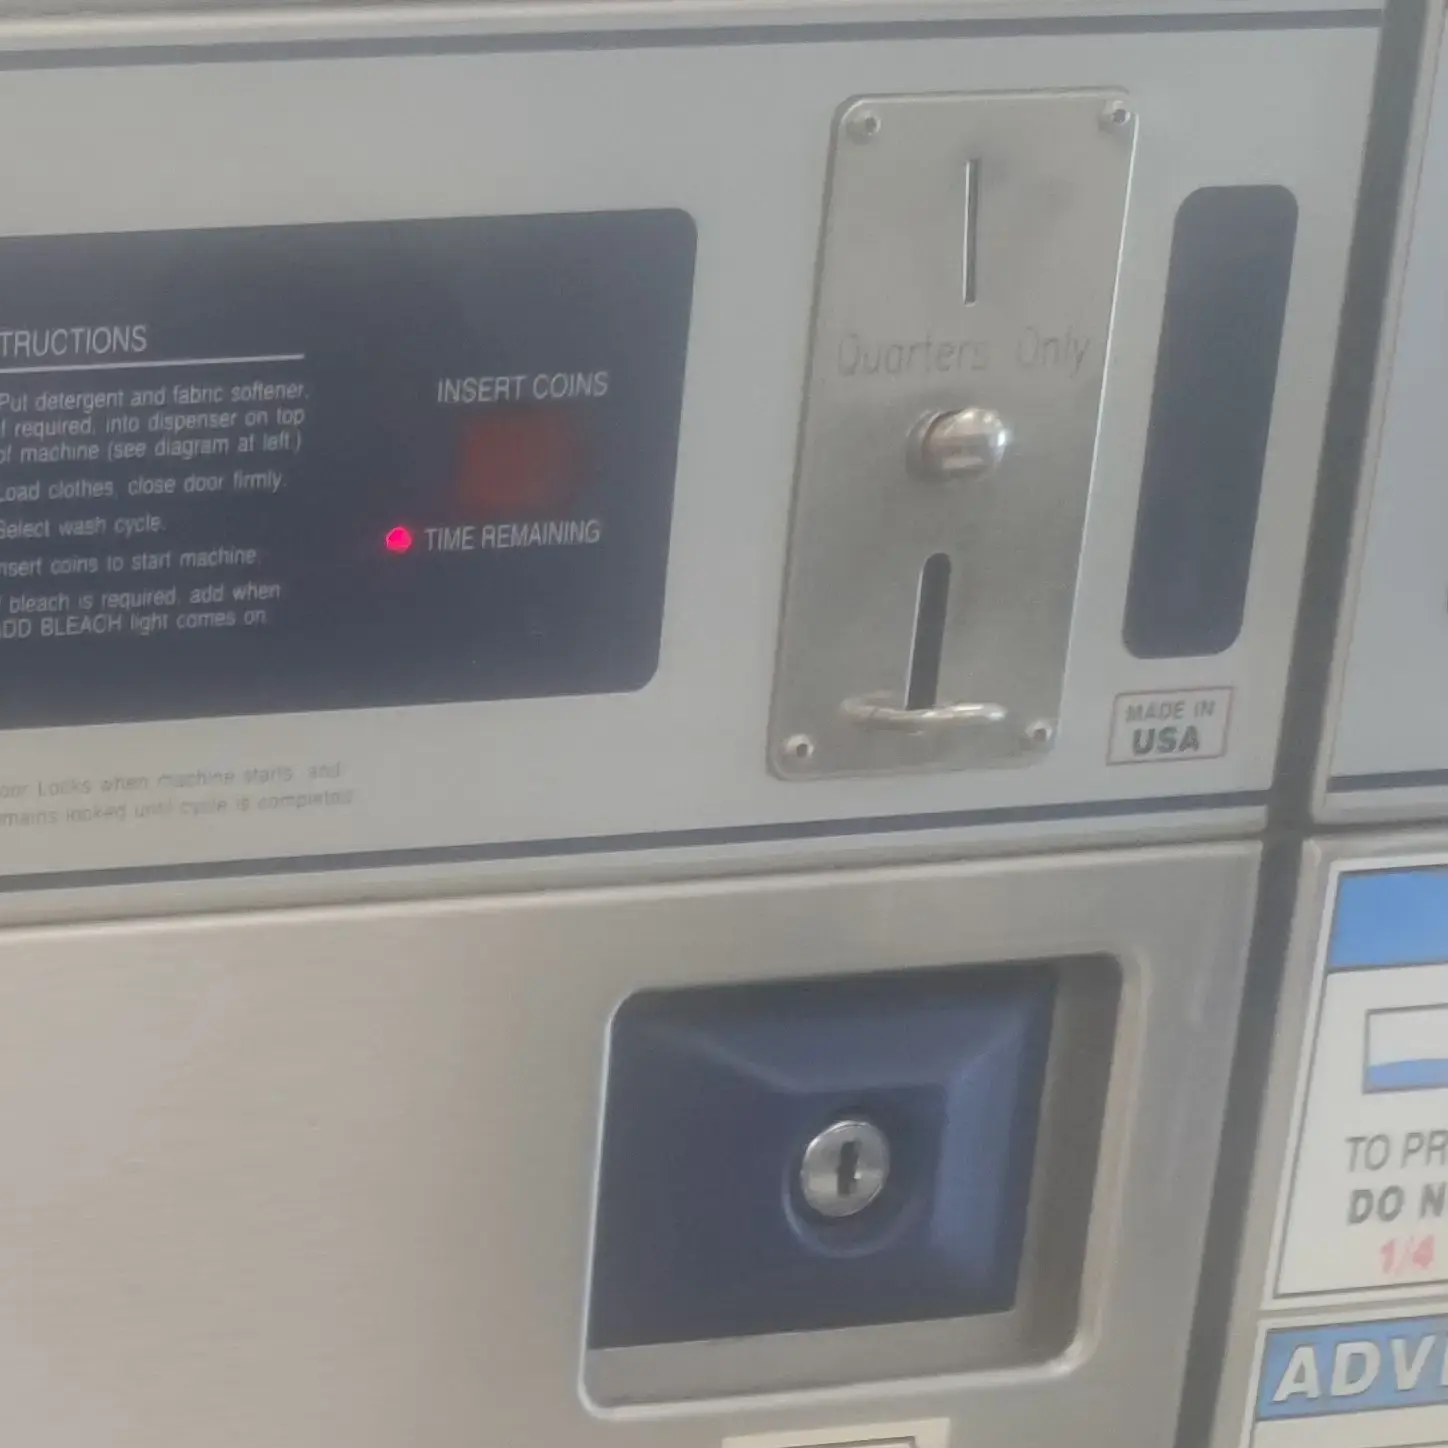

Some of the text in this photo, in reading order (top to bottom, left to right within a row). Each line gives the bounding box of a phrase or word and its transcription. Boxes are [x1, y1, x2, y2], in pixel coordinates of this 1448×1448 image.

[836, 324, 1092, 378] Quarters Only
[34, 389, 124, 414] detergent
[129, 387, 165, 407] and
[172, 384, 223, 404] fabric
[436, 370, 610, 404] INSERT COINS
[105, 414, 140, 434] into
[147, 410, 238, 438] dispenser
[244, 411, 269, 427] on
[276, 407, 306, 430] top
[20, 441, 100, 464] machine
[107, 438, 147, 465] (see
[154, 434, 229, 461] diagram
[237, 433, 256, 452] at
[127, 475, 176, 496] close
[183, 473, 224, 494] door
[58, 514, 107, 536] wash
[424, 518, 602, 552] TIME REMAINING
[49, 554, 99, 575] coins
[106, 553, 124, 572] to
[130, 550, 172, 571] start
[8, 591, 70, 614] bleach
[77, 592, 94, 610] is
[189, 585, 224, 605] add
[232, 581, 281, 602] when
[39, 613, 123, 637] BLEACH
[129, 610, 169, 636] light
[176, 608, 237, 630] comes
[1124, 699, 1217, 723] MADE IN
[1131, 724, 1200, 755] USA
[1344, 1133, 1391, 1173] TO
[1346, 1184, 1406, 1226] DO
[1272, 1334, 1448, 1403] ADV
